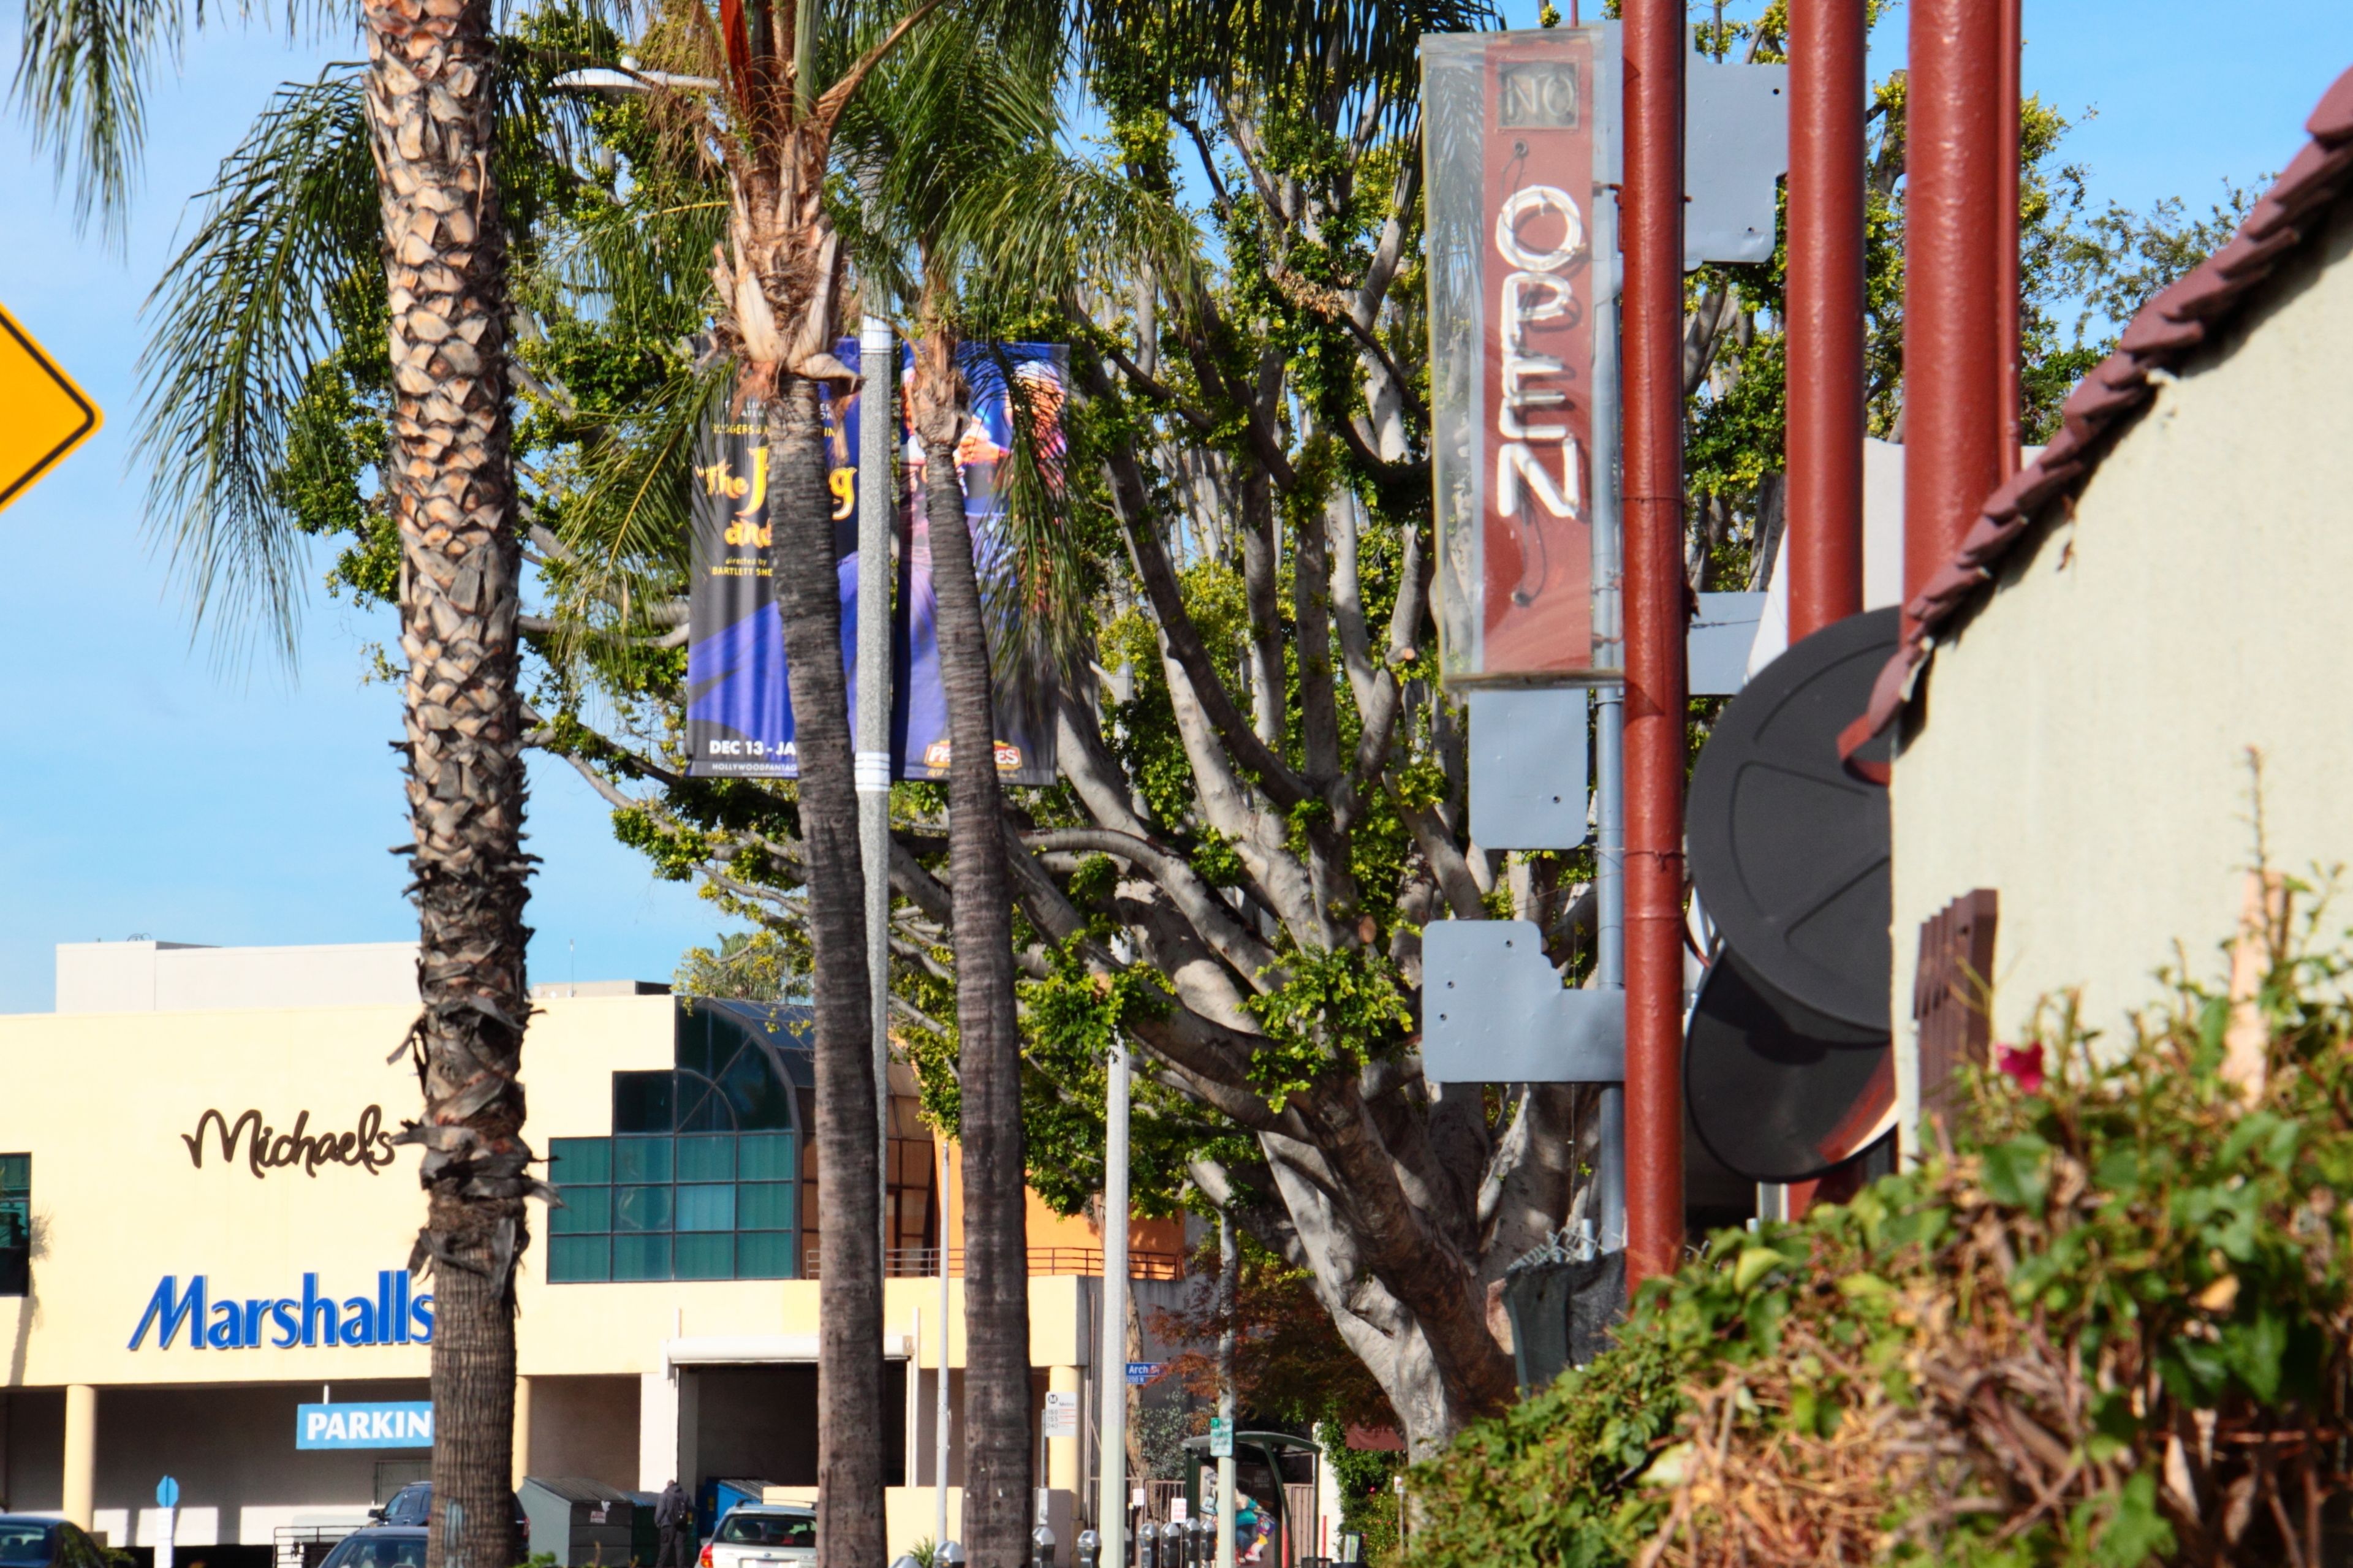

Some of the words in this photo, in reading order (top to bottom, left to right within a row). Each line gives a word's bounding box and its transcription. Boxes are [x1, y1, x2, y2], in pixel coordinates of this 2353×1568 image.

[1506, 74, 1575, 116] NO
[1495, 184, 1583, 520] OPEN
[695, 458, 749, 499] The
[712, 566, 753, 576] BARTLETT
[756, 567, 773, 577] SHE
[710, 740, 740, 755] DEC
[745, 740, 764, 755] 13
[775, 741, 797, 756] JA
[712, 763, 798, 772] HOLLYWOODPANTAG
[181, 1104, 396, 1178] Michaels
[127, 1268, 435, 1351] Marshalls
[1128, 1365, 1148, 1374] Arch
[306, 1410, 431, 1441] PARKIN
